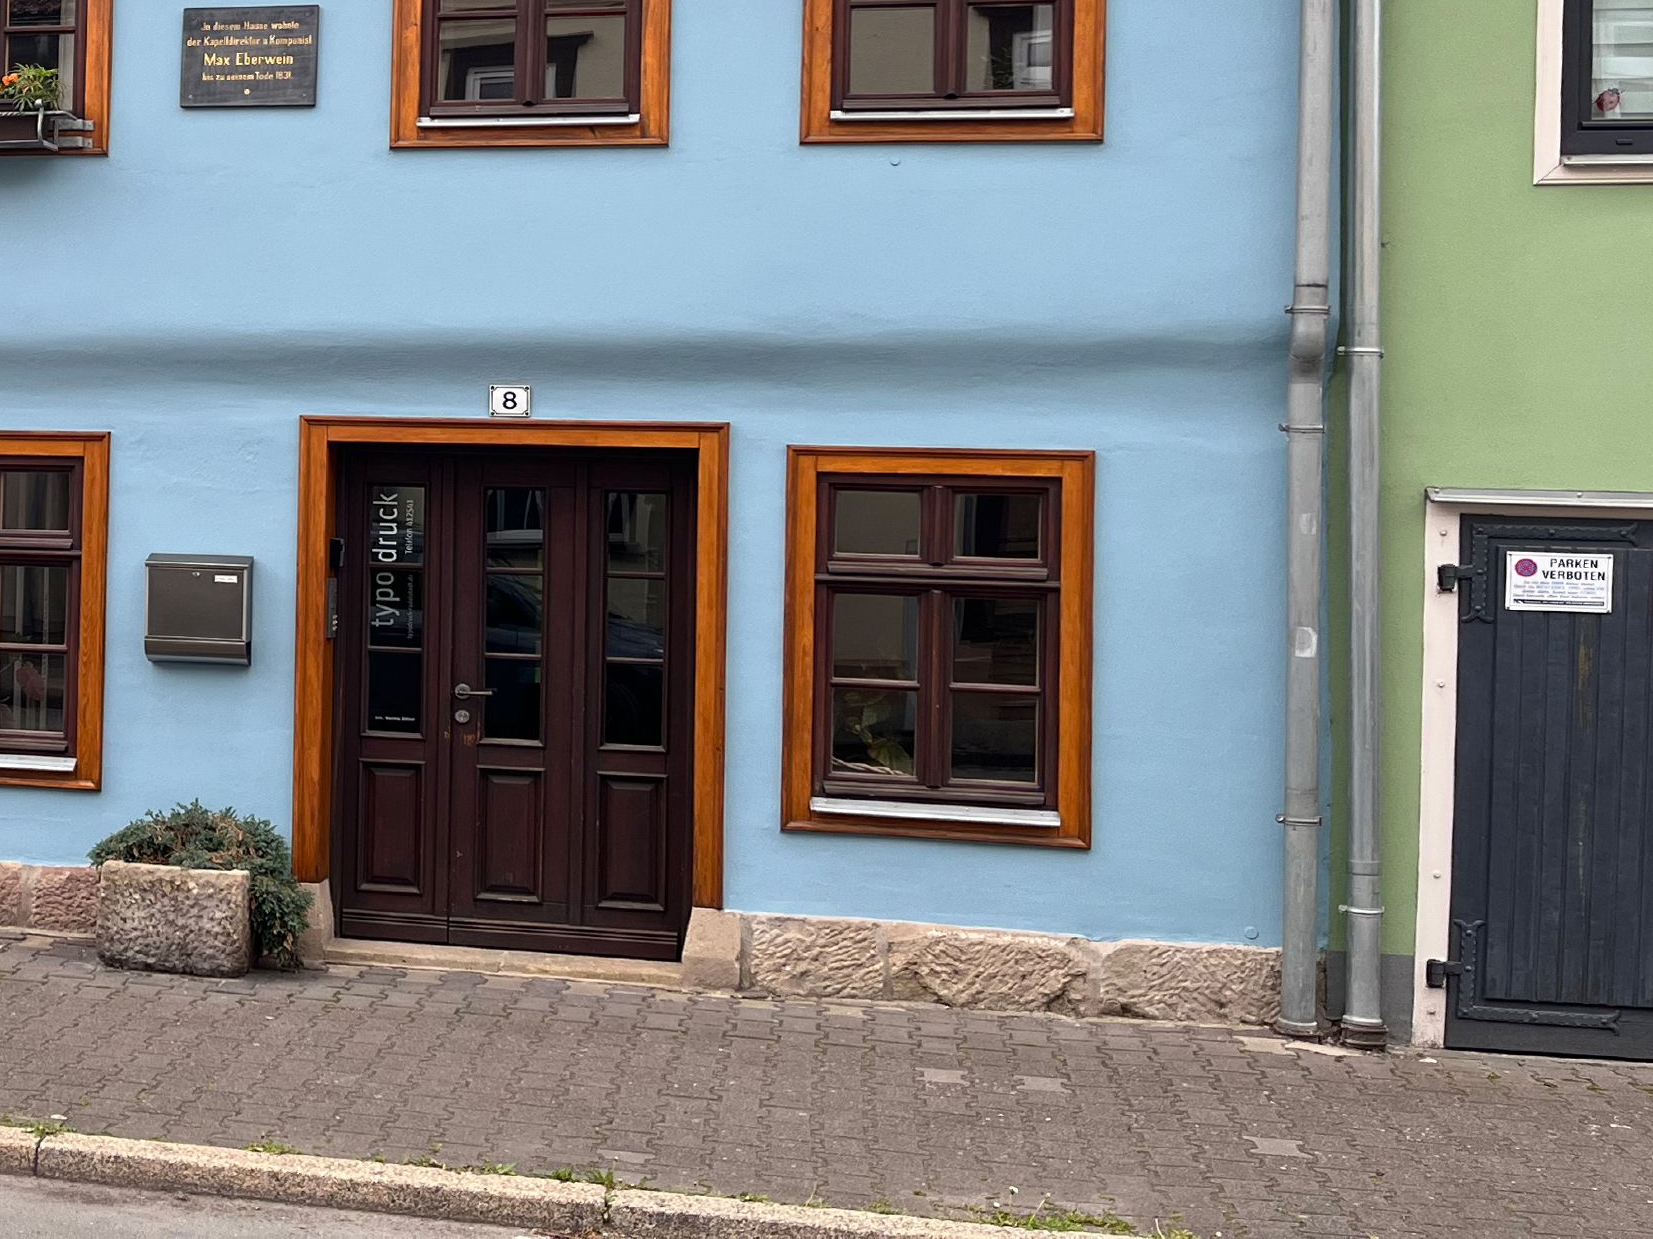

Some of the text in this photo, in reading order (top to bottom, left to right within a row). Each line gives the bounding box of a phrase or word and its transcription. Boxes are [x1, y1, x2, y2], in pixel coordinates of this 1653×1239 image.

[213, 21, 241, 30] diesem
[243, 20, 268, 30] Hause
[270, 20, 300, 30] wohnte
[186, 36, 202, 47] der
[269, 34, 312, 46] Komponist
[203, 52, 294, 66] Max Eberwein
[202, 72, 215, 81] bis
[254, 71, 274, 80] Tode
[502, 391, 517, 410] 8
[371, 493, 400, 627] typo druck
[1550, 558, 1598, 569] PARKEN
[1542, 570, 1606, 581] VERBOTEN
